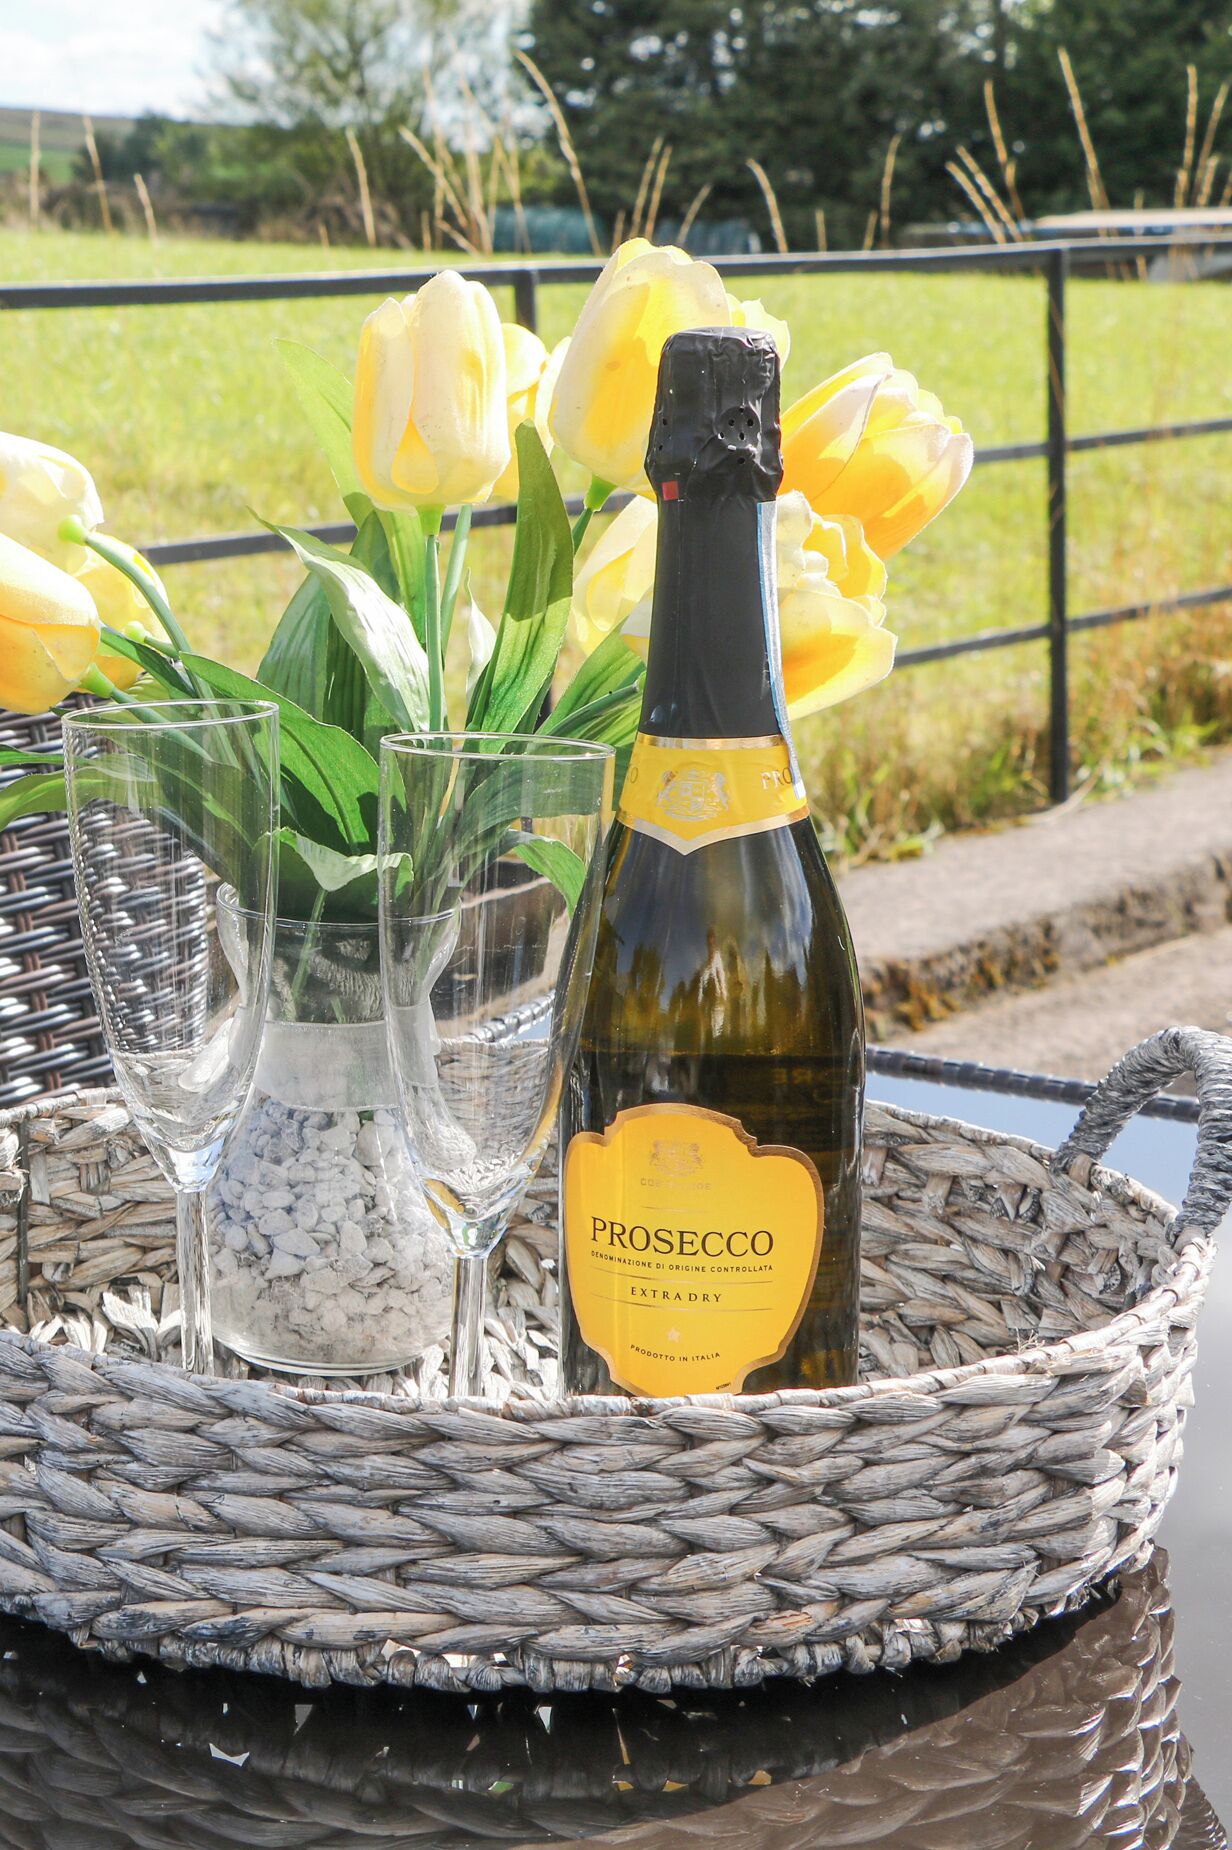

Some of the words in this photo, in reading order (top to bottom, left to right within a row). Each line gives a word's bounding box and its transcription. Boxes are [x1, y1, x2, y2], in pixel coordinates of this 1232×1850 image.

[591, 1217, 774, 1257] PROSECCO
[591, 1250, 652, 1268] DENOMINAZIONE
[669, 1264, 706, 1272] ORIGINE
[711, 1264, 773, 1272] CONTROLLATA
[630, 1345, 675, 1362] PRODOTTO
[692, 1352, 721, 1361] ITALIA
